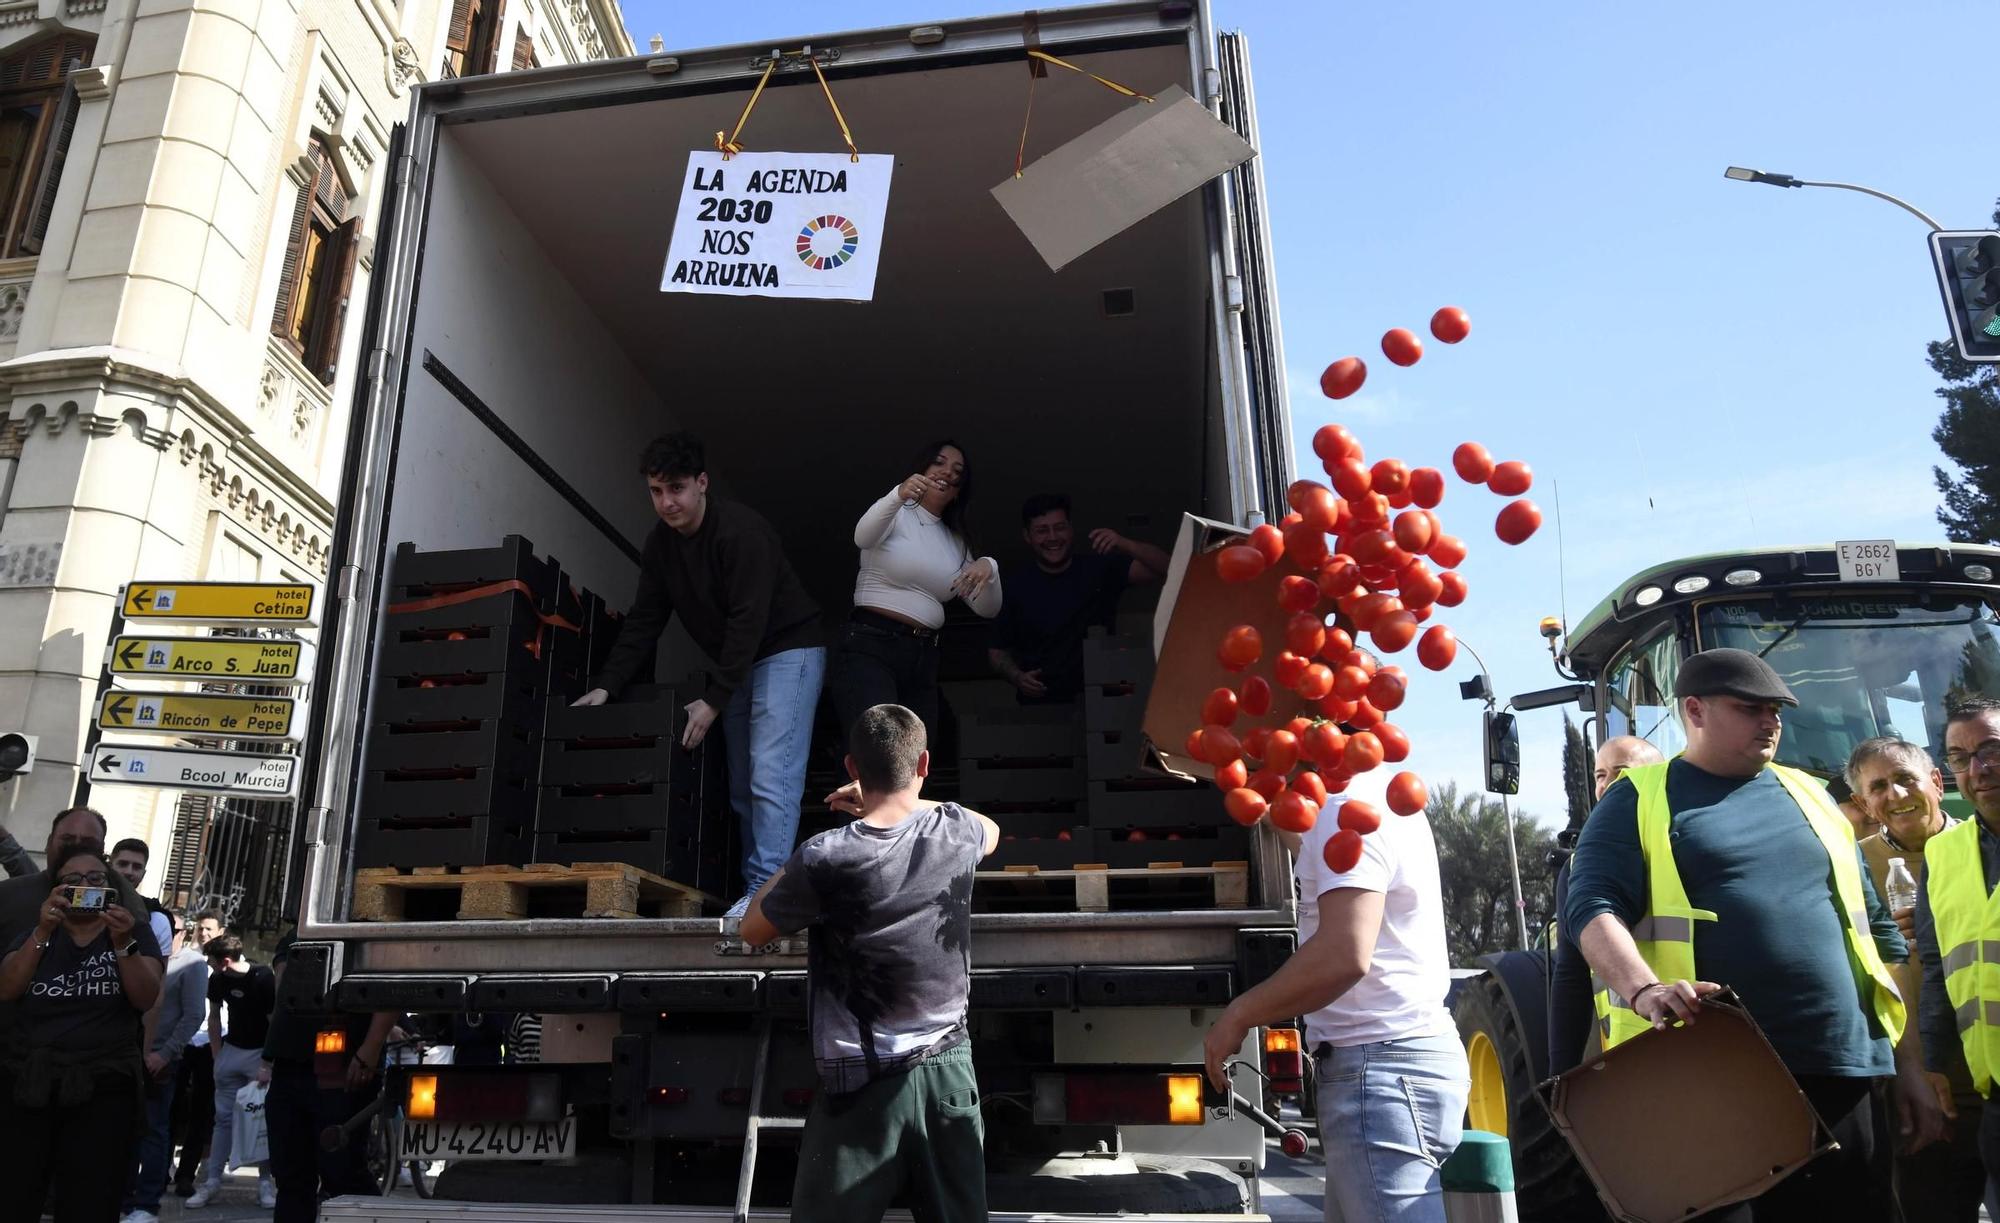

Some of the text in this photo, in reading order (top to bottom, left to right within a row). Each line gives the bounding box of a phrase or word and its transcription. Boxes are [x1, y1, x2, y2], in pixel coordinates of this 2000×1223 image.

[693, 167, 847, 194] LA AGENDA
[697, 197, 773, 224] 2030
[700, 229, 754, 255] NOS
[672, 260, 779, 288] ARRUINA
[1841, 544, 1890, 559] E 2662
[1855, 563, 1882, 577] BGY
[275, 589, 307, 600] hotel
[254, 602, 304, 615] Cetina
[261, 646, 293, 657] hotel
[173, 656, 290, 674] Arco S. Juan
[253, 703, 286, 715] hotel
[161, 712, 283, 732] Rincón de Pepe
[259, 761, 289, 773] hotel
